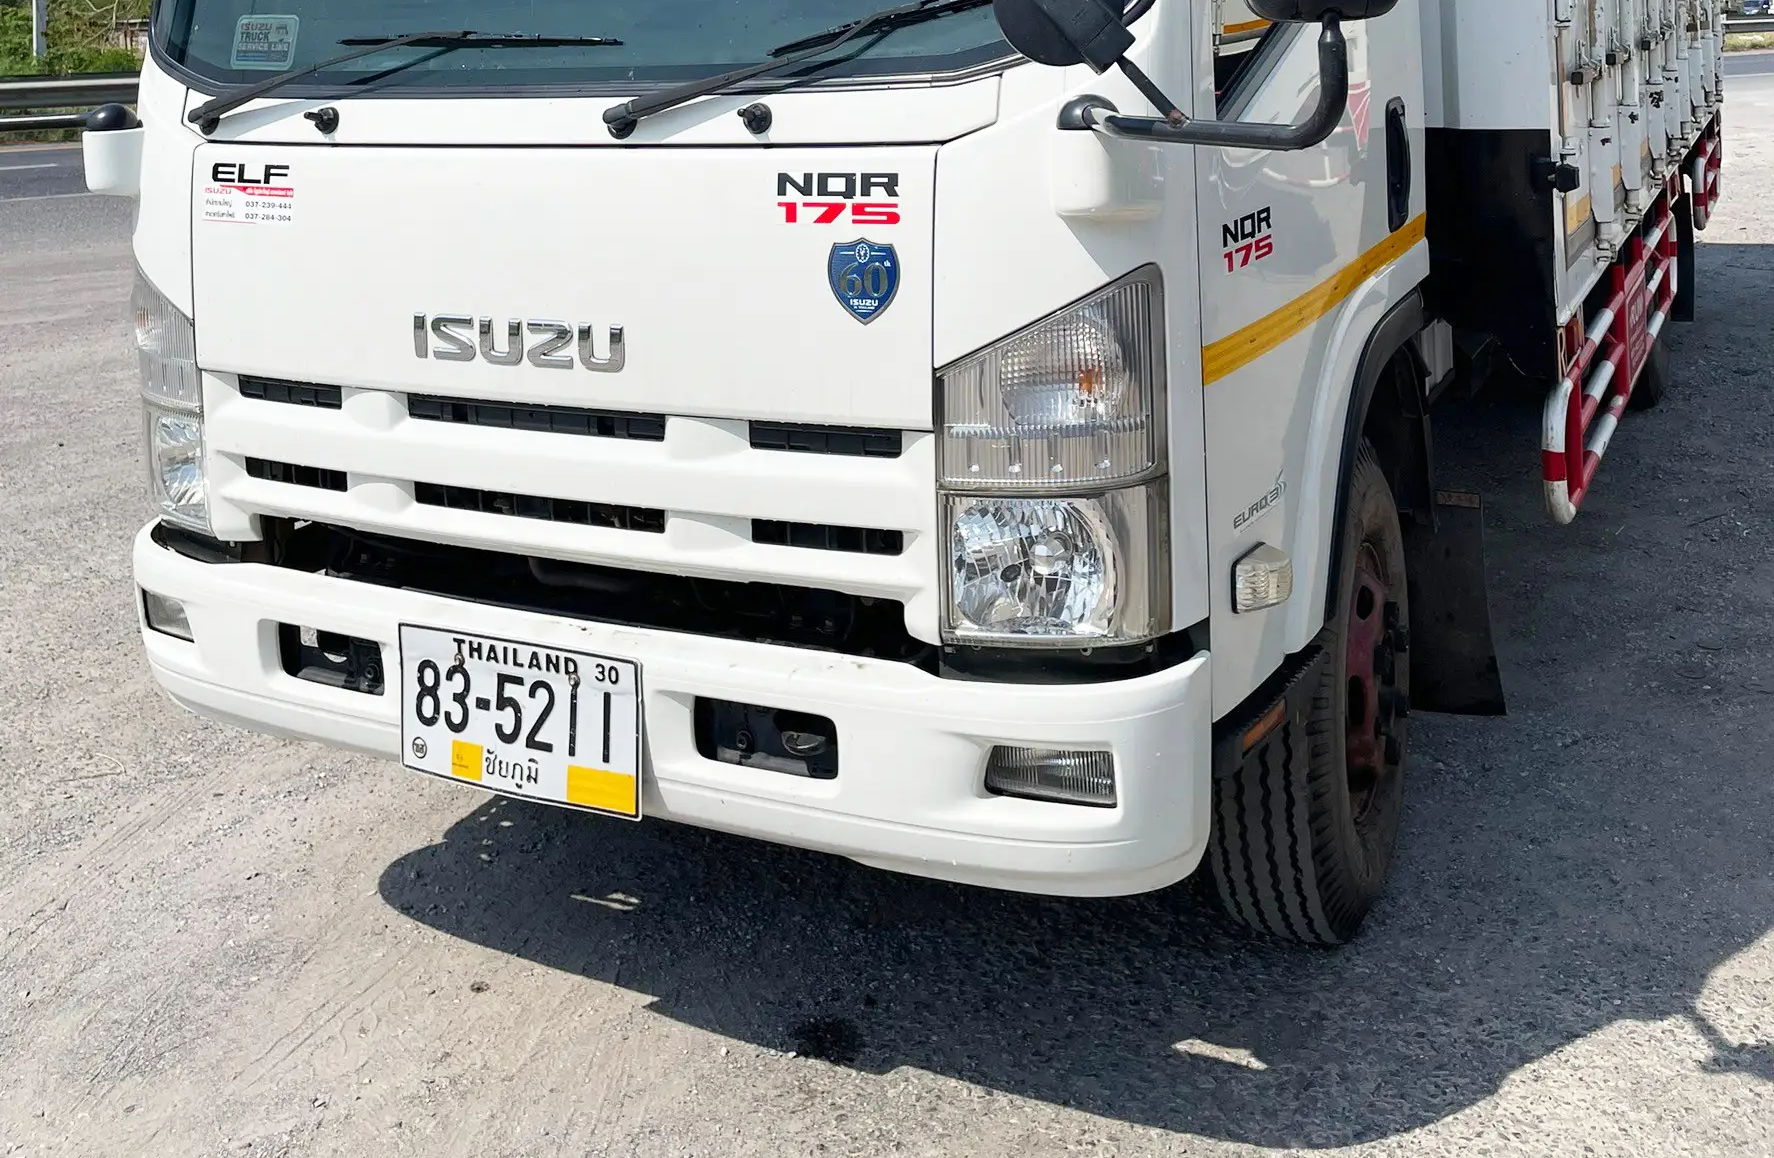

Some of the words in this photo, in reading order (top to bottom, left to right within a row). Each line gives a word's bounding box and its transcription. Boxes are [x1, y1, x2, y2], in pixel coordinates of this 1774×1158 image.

[240, 23, 273, 31] ISUZU
[240, 32, 270, 41] TRUCK
[238, 42, 268, 51] SERVICE
[271, 43, 289, 51] LINE
[212, 162, 290, 184] ELF
[777, 172, 899, 199] NQR
[204, 187, 232, 195] ISUZU
[777, 201, 901, 225] 175
[1222, 205, 1272, 248] NQR
[1223, 233, 1274, 273] 175
[849, 298, 879, 307] ISUZU
[413, 311, 626, 373] ISUZU
[453, 637, 579, 675] THAILAND
[595, 663, 620, 685] 30
[415, 658, 612, 764] 83-5211
[484, 748, 539, 790] ชัยภูมิ
